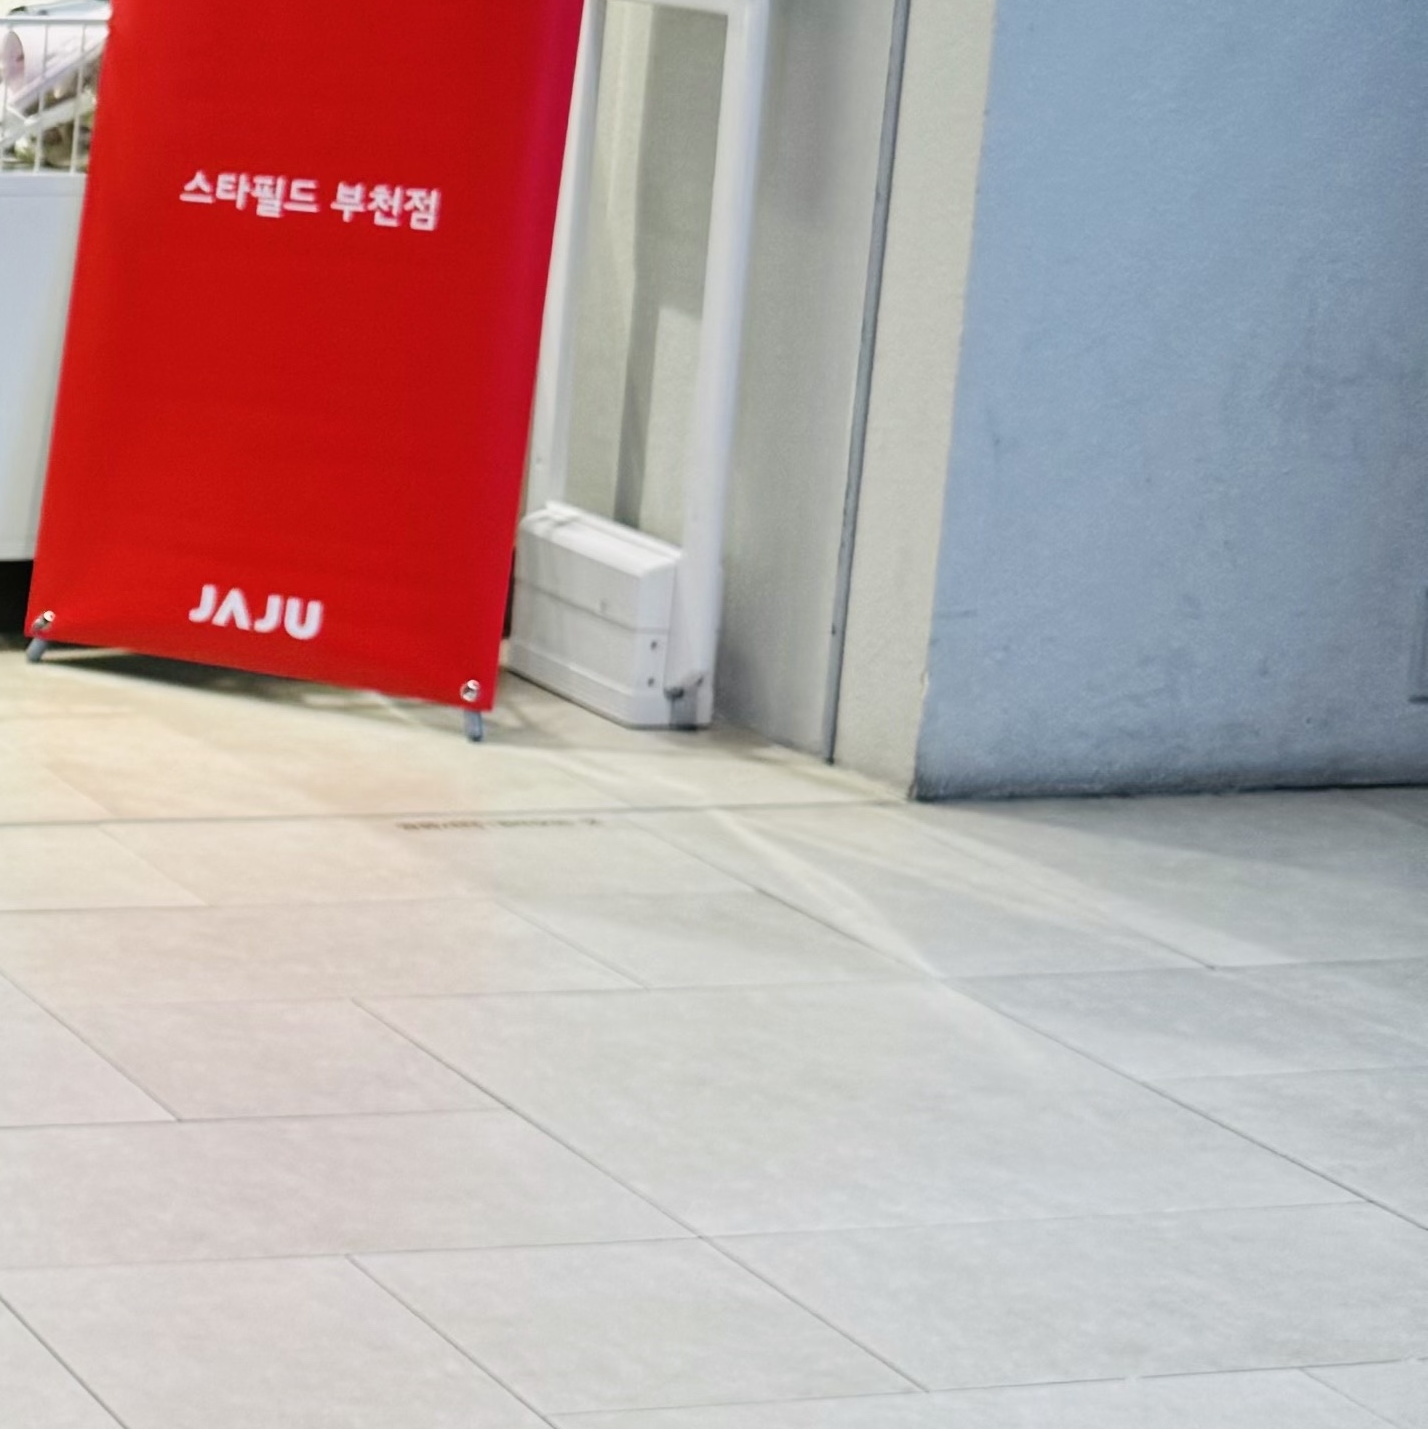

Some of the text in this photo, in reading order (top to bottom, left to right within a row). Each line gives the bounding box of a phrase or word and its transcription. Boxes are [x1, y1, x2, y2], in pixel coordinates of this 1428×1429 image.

[179, 169, 442, 232] 스타필드 부천점
[188, 584, 323, 640] JAJU
